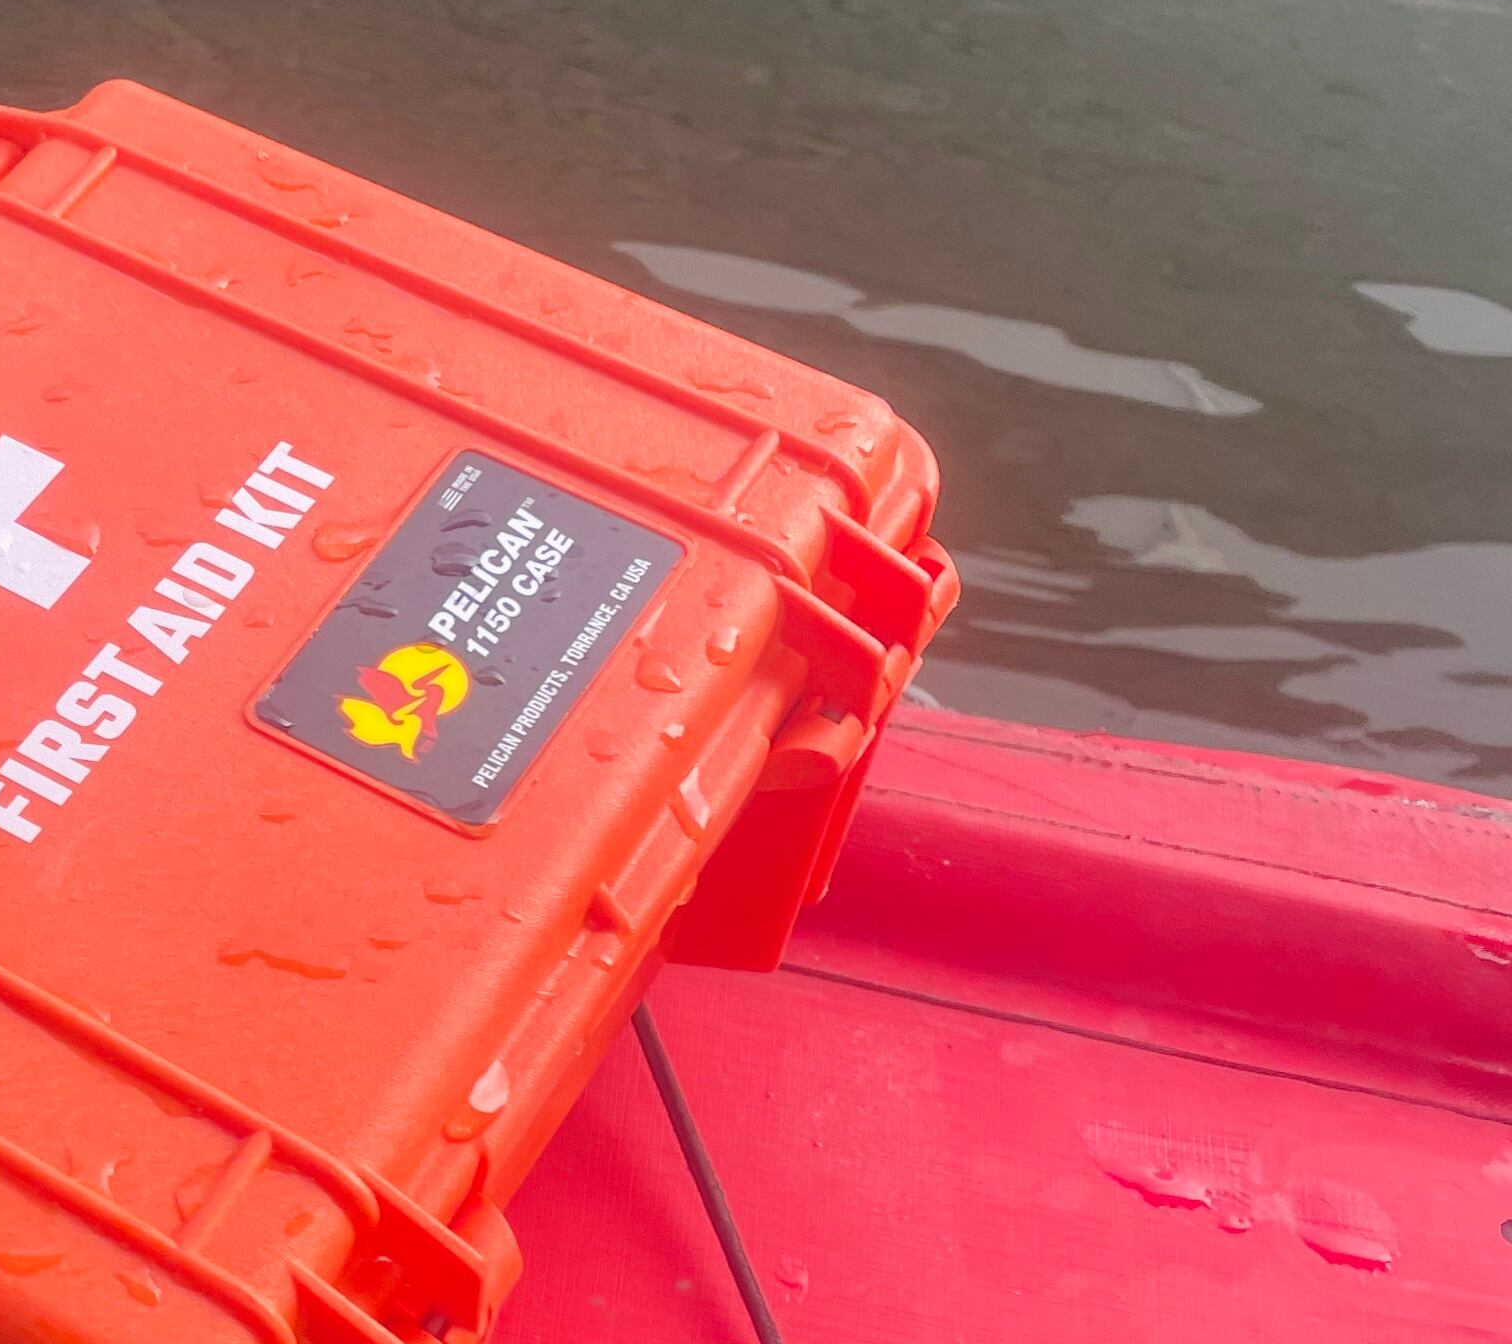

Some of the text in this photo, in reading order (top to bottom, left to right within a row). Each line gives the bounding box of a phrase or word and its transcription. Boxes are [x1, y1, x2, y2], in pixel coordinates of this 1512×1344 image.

[126, 542, 256, 665] AID
[214, 440, 336, 550] KIT
[466, 527, 575, 657] 1150 CASE
[471, 558, 653, 789] PELICAN PRODUCTS, TORRANCE, CA USA
